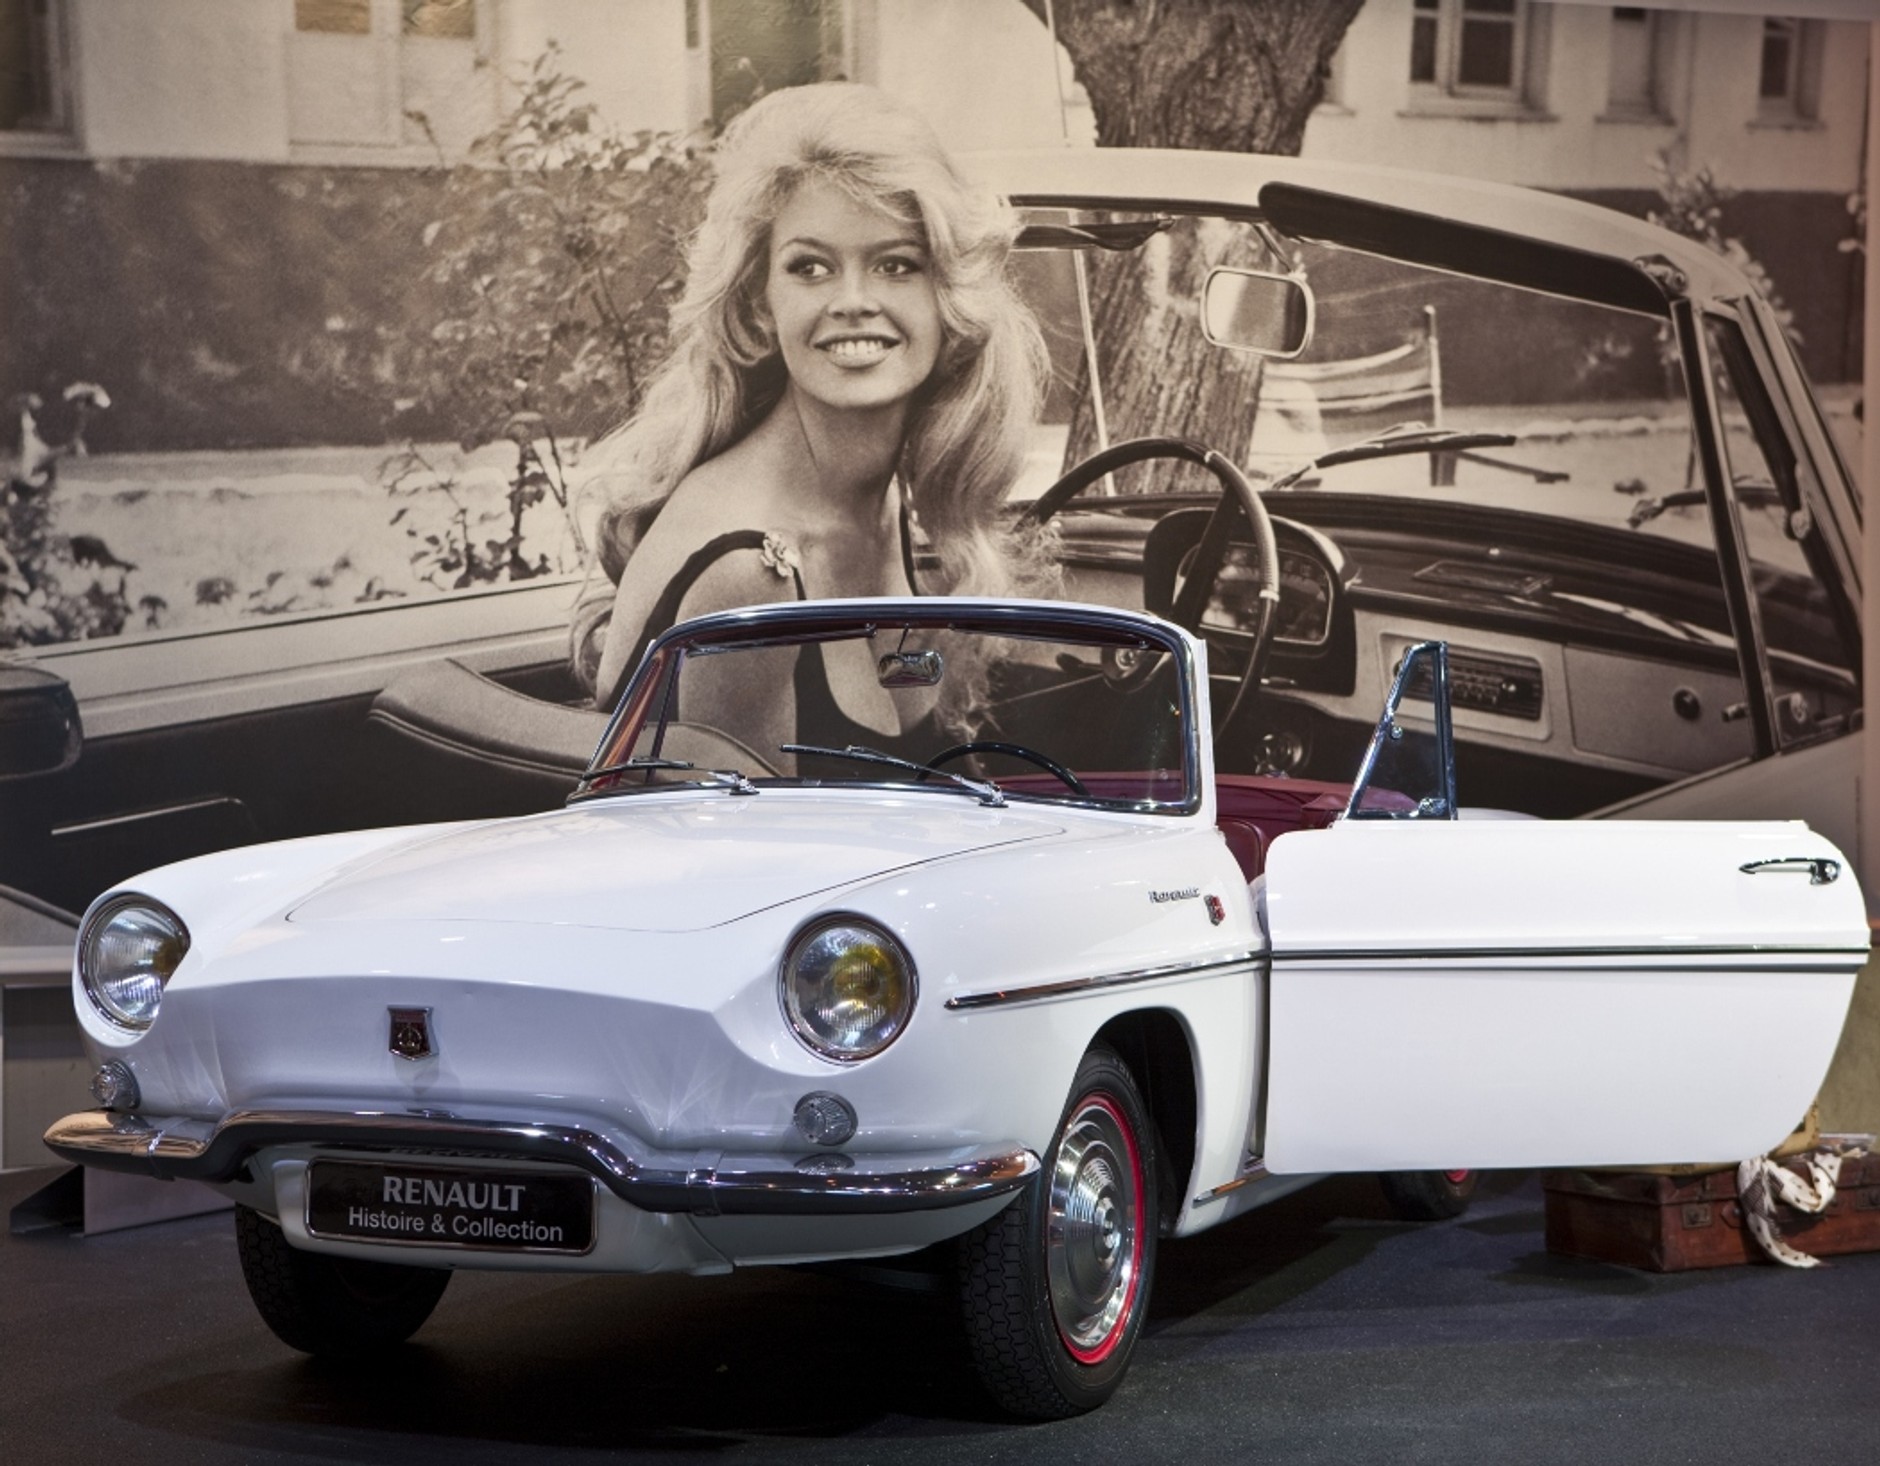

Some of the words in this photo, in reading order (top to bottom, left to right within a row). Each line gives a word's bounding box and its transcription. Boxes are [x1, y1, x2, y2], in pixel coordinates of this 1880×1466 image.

[383, 1176, 525, 1211] RENAULT
[349, 1206, 425, 1232] Histoire
[431, 1213, 446, 1234] &
[452, 1215, 563, 1242] Collection
